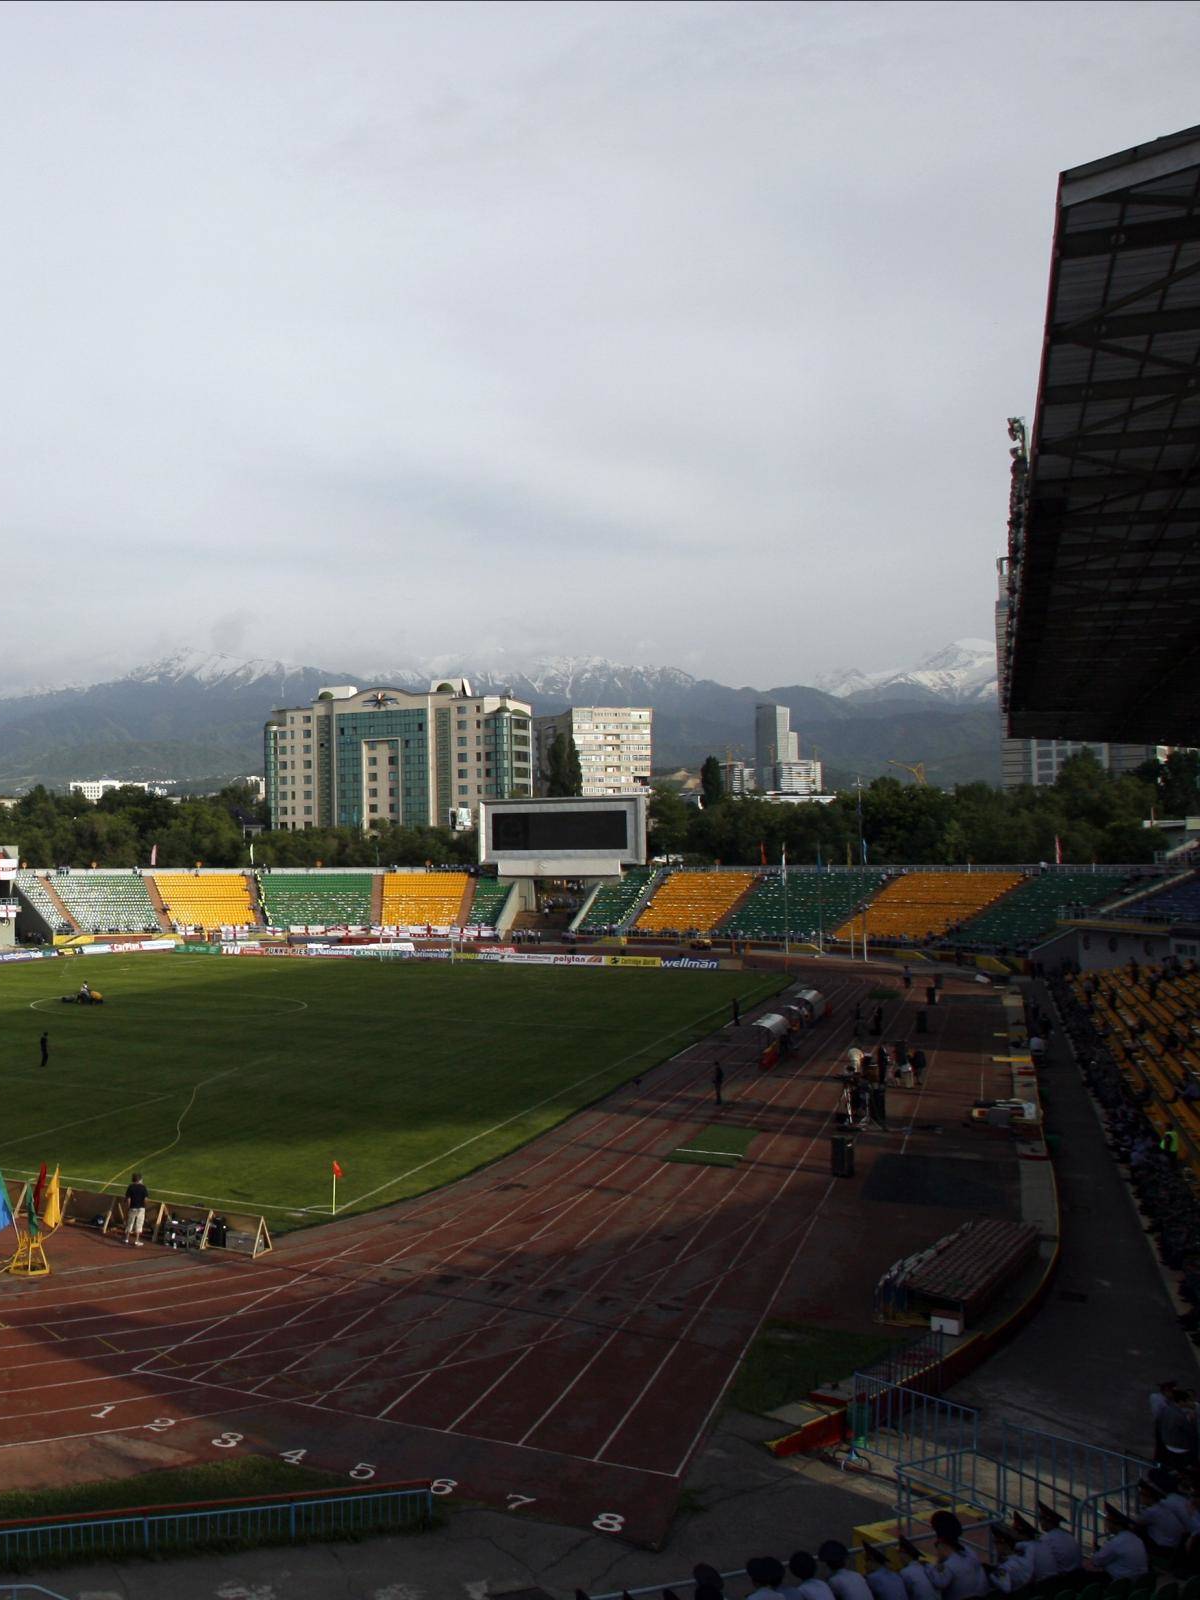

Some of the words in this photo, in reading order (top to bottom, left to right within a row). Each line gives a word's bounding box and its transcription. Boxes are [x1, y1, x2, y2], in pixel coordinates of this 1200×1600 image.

[222, 946, 241, 955] TVU
[553, 956, 586, 965] polytan
[660, 958, 718, 969] wellman
[90, 1405, 116, 1419] 1
[143, 1417, 177, 1432] 2
[211, 1432, 244, 1448] 3
[279, 1449, 308, 1465] 4
[349, 1462, 377, 1480] 5
[430, 1478, 459, 1495] 6
[506, 1493, 537, 1510] 7
[591, 1512, 625, 1532] 8
